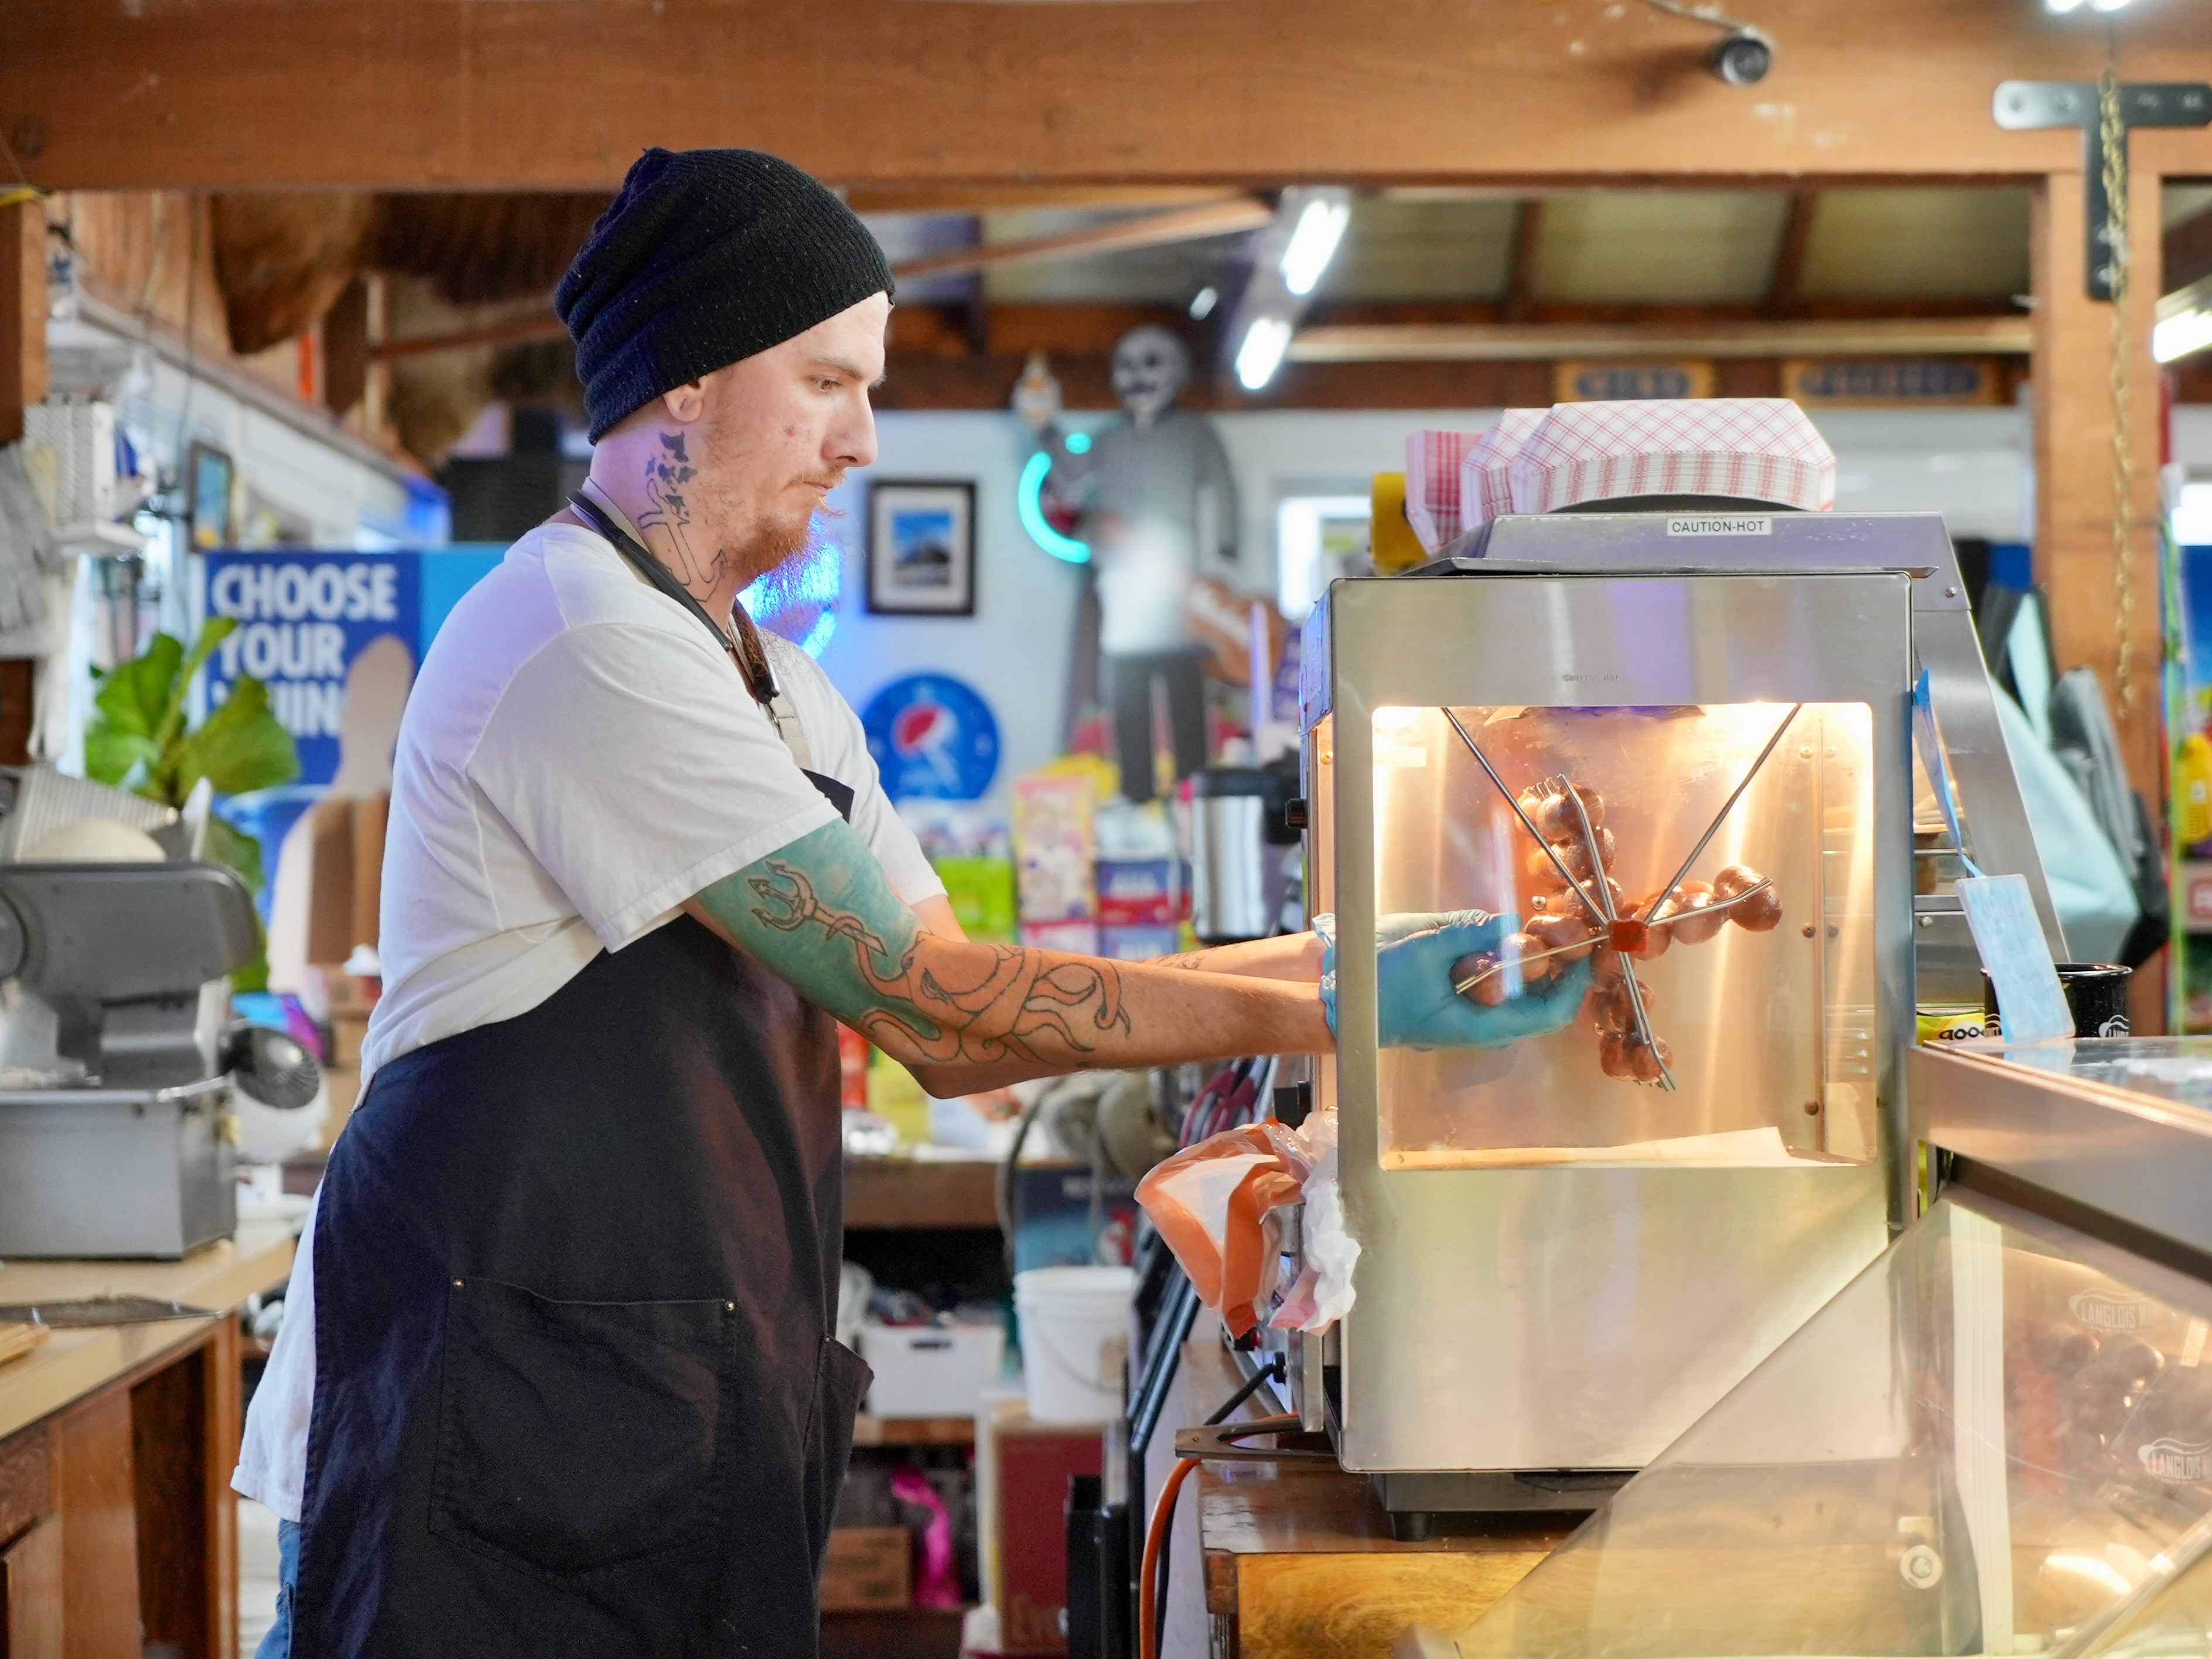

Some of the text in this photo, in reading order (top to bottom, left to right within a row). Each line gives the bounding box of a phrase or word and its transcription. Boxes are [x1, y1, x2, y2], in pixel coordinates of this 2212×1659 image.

[1672, 521, 1764, 532] CAUTION-HOT
[211, 562, 399, 621] CHOOSE
[220, 622, 346, 680] YOUR
[2080, 1299, 2136, 1329] LANGLOIS
[2151, 1452, 2201, 1480] LANGLOIS
